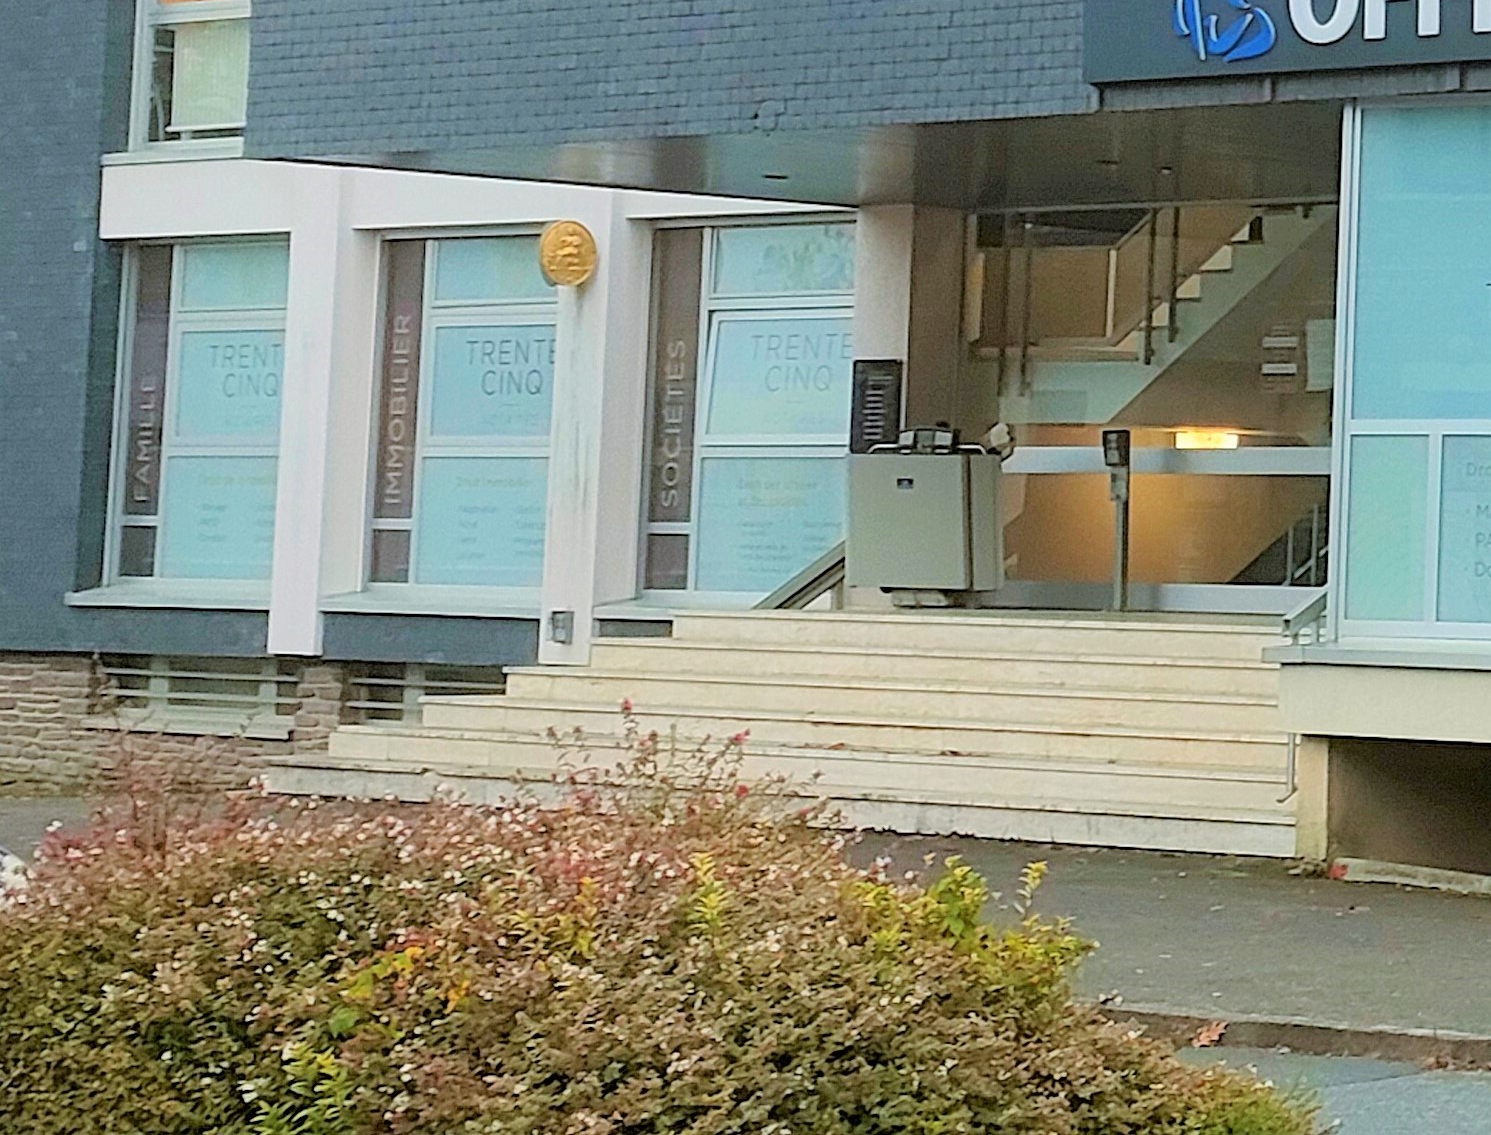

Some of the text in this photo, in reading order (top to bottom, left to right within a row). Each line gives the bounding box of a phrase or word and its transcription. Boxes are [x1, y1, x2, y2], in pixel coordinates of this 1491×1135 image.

[209, 343, 283, 369] TRENT
[751, 333, 853, 361] TRENTE
[223, 372, 279, 398] CINQ
[481, 370, 543, 395] CINQ
[765, 366, 833, 392] CINQ
[384, 314, 412, 505] IMMOBILIER
[134, 376, 159, 501] FAMILLE
